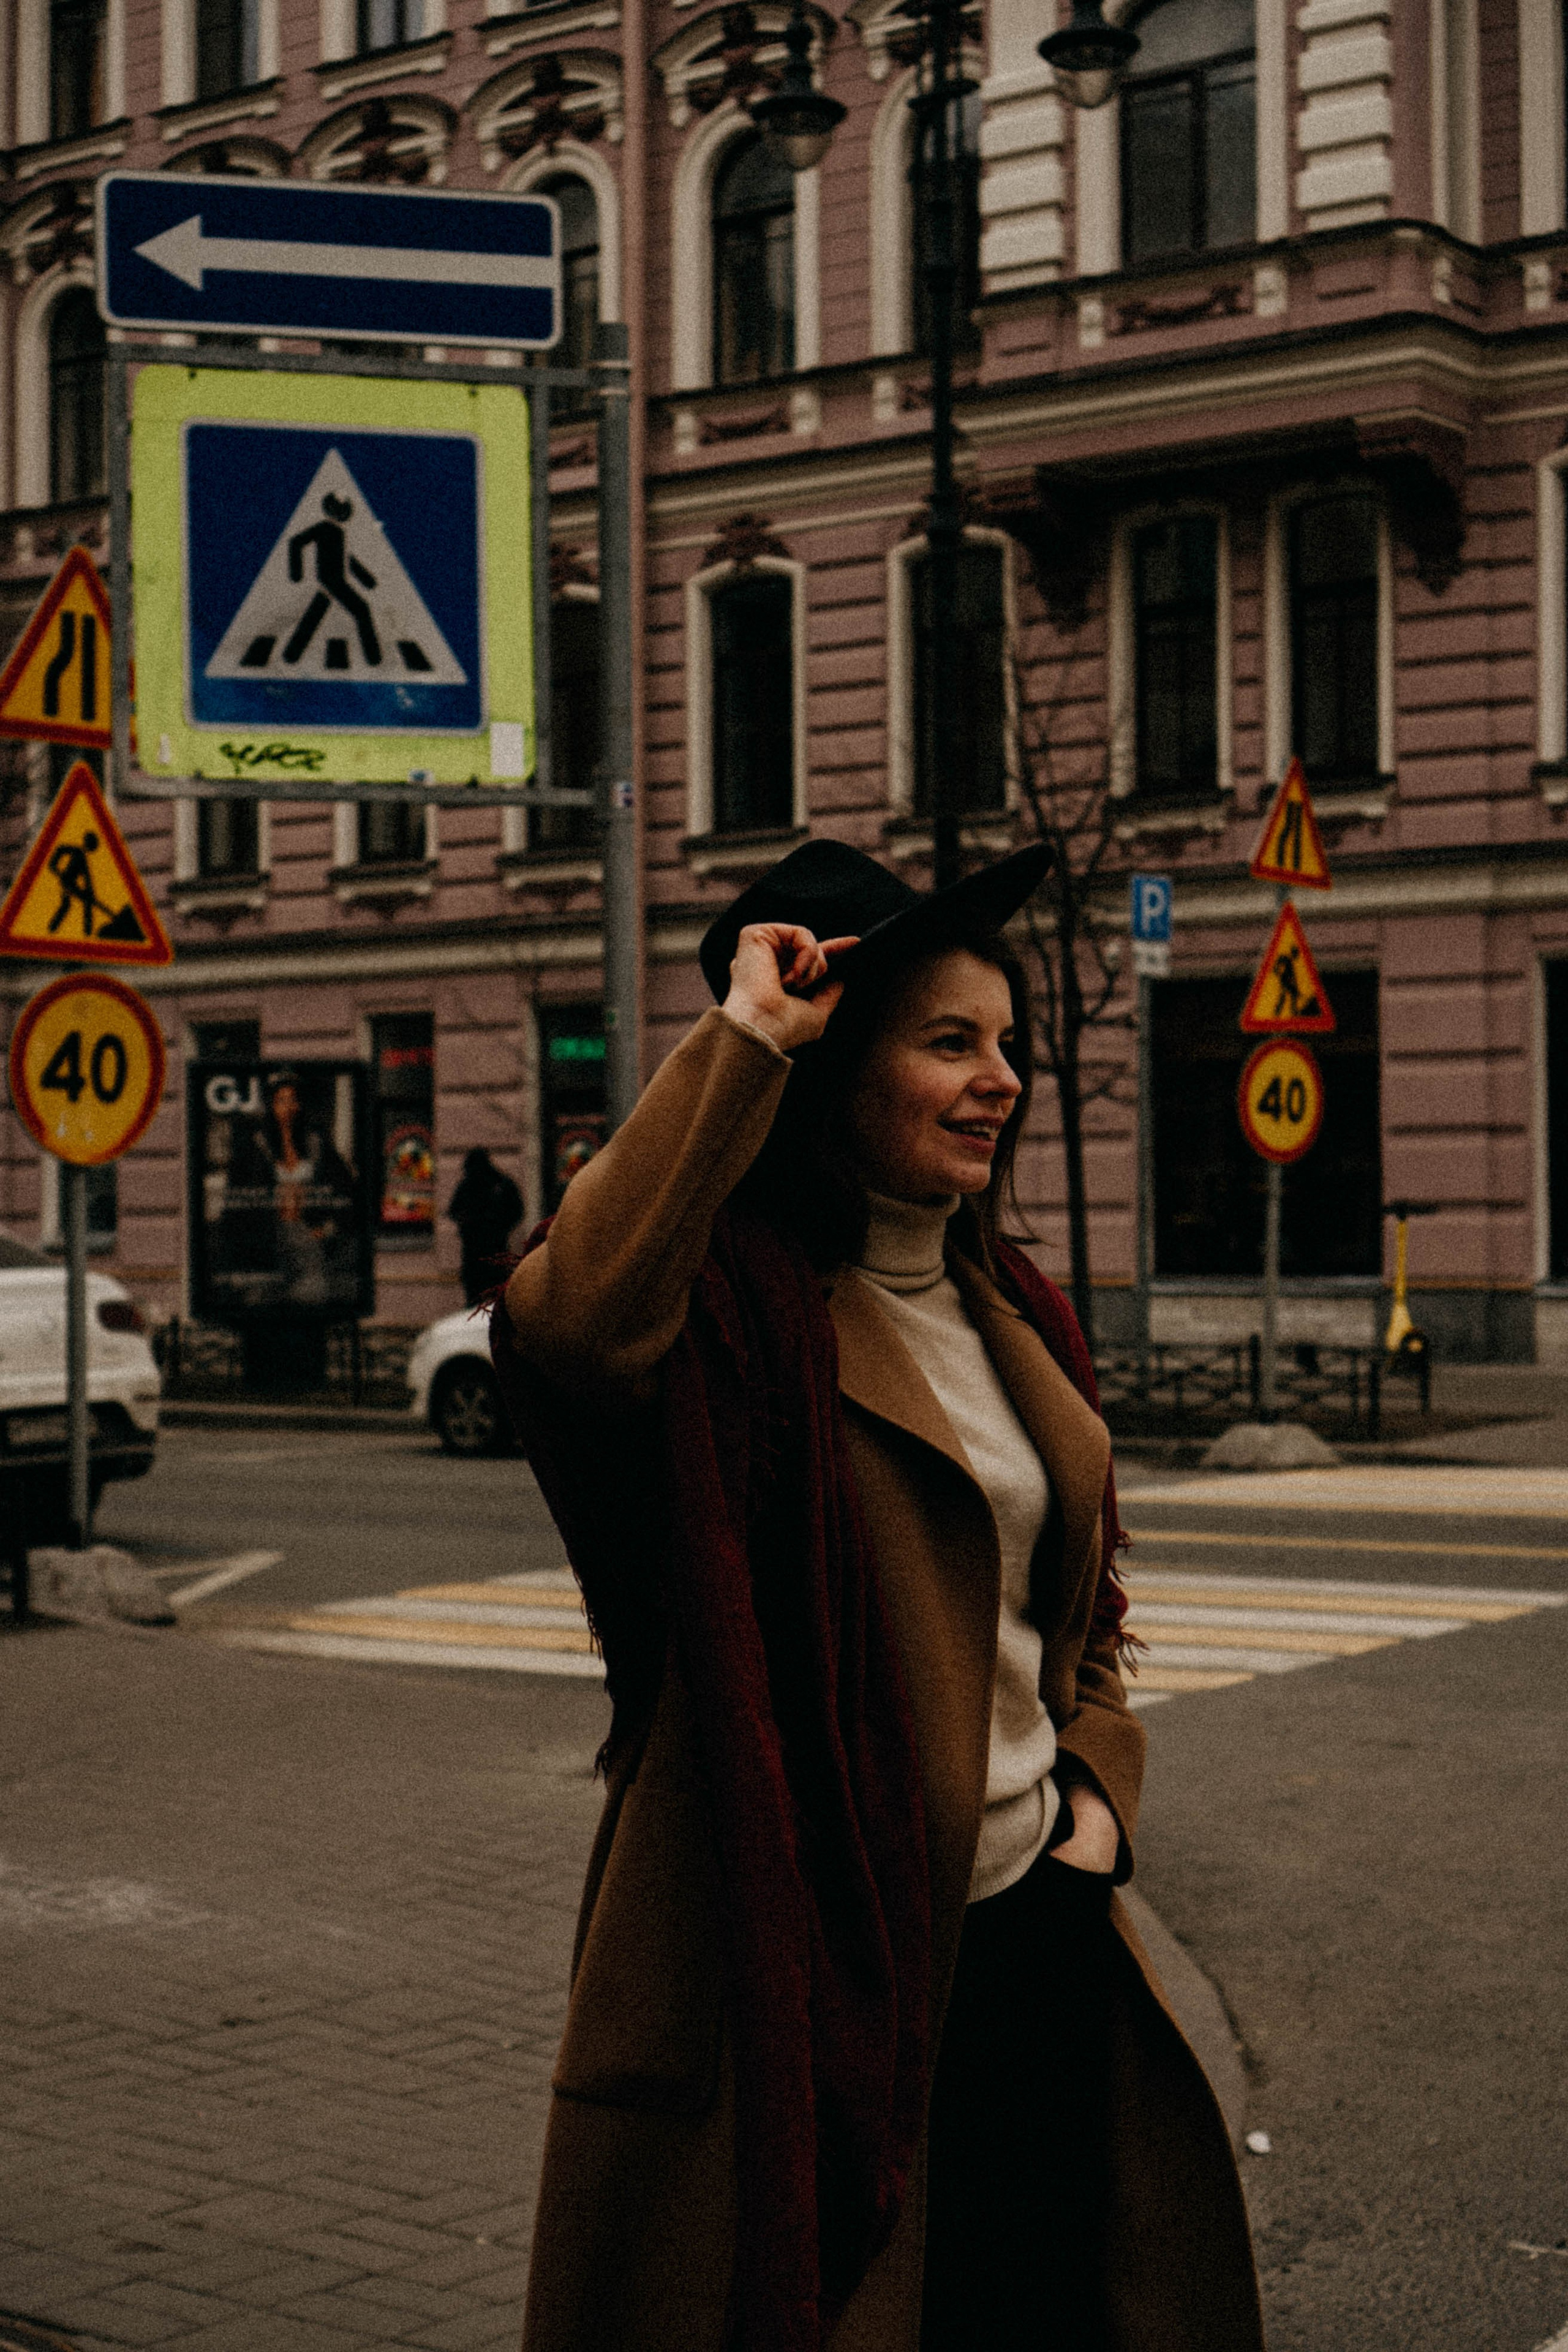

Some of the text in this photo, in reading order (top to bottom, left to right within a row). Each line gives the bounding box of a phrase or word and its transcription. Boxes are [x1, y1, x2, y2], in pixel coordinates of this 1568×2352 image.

[1140, 883, 1166, 933] P
[42, 1031, 126, 1103] 40
[1258, 1077, 1305, 1123] 40
